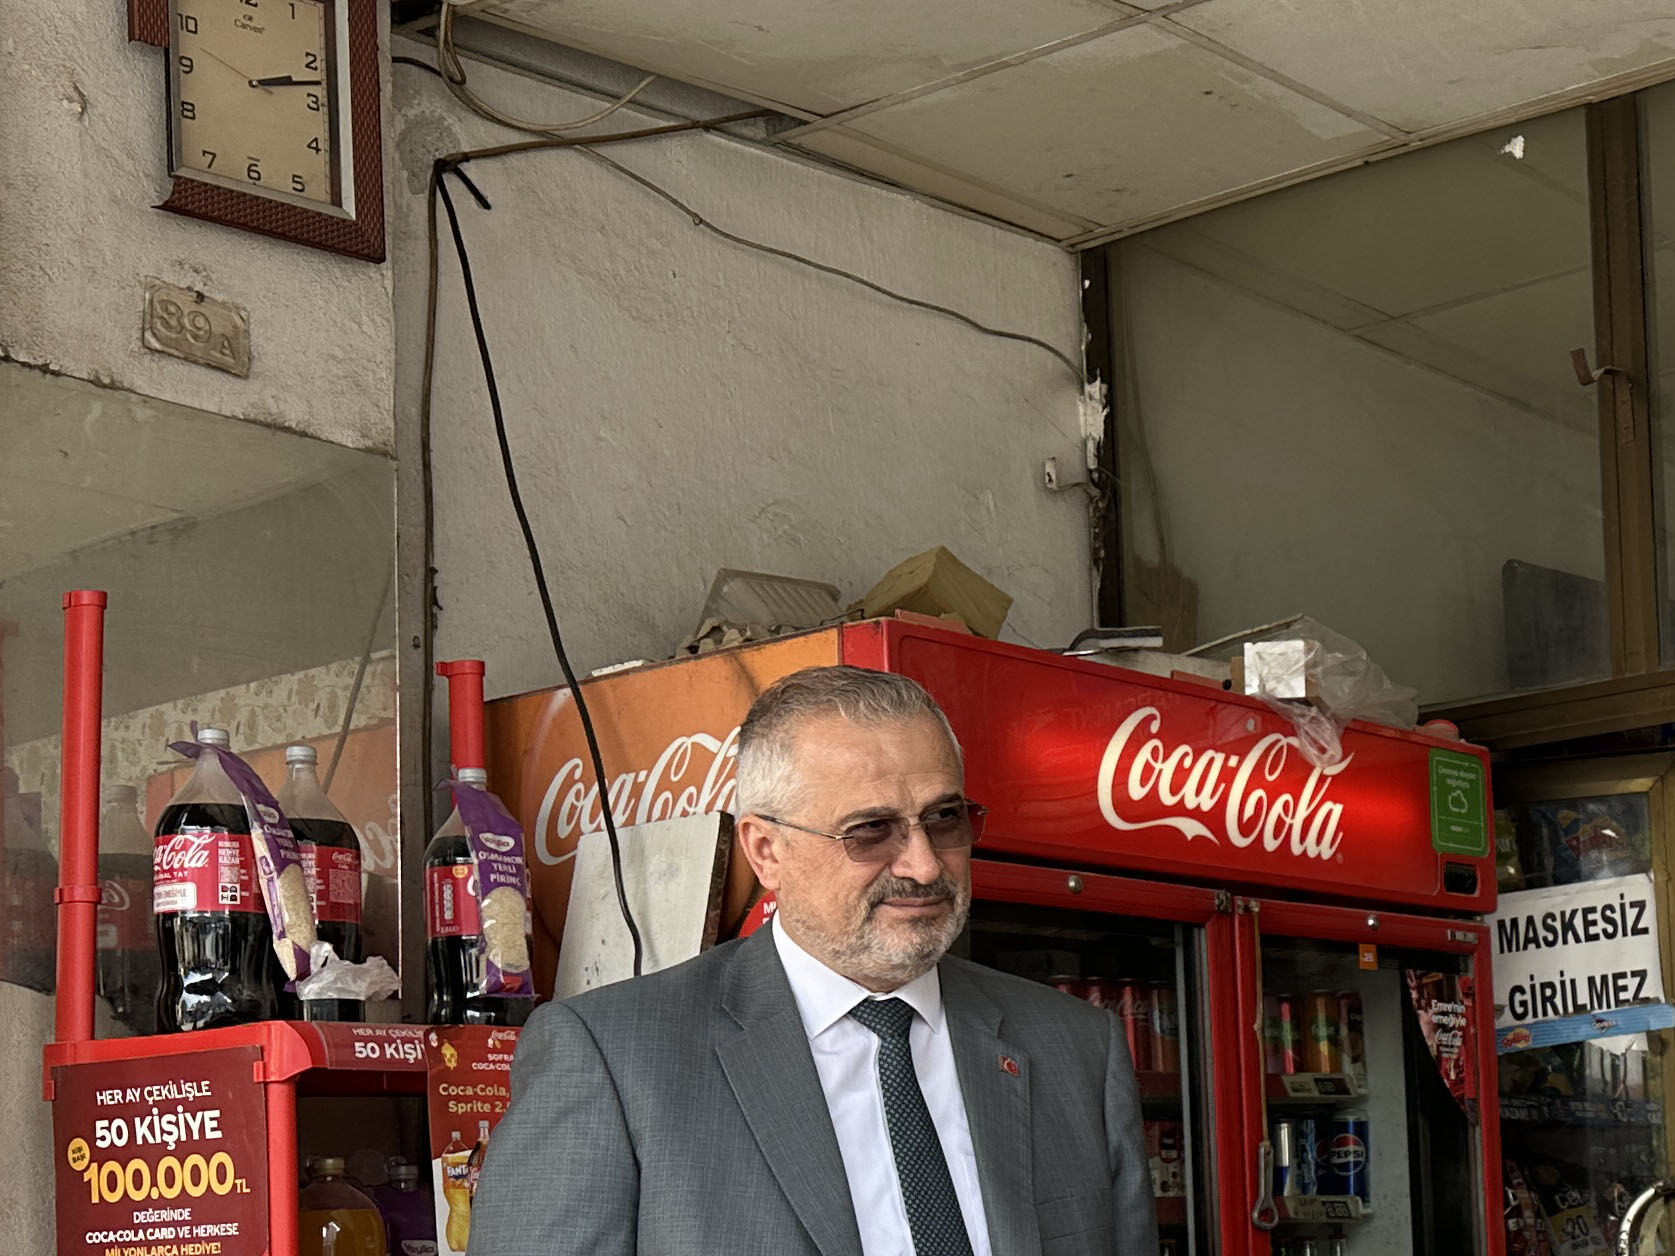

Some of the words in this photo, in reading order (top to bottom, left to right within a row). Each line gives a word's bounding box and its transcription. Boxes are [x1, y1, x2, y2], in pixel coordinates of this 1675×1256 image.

[178, 13, 199, 35] 10
[179, 55, 194, 75] 9
[304, 52, 319, 71] 2
[181, 101, 197, 121] 8
[306, 92, 321, 112] 3
[306, 136, 322, 155] 4
[202, 149, 218, 169] 7
[247, 163, 262, 182] 6
[291, 174, 306, 193] 5
[1097, 705, 1355, 862] Coca-Cola
[1496, 892, 1650, 956] MASKESİZ
[1507, 969, 1649, 1022] GİRİLMEZ
[354, 1041, 381, 1059] 50
[384, 1039, 426, 1064] KİŞİ
[471, 1062, 512, 1071] COCA-COL
[96, 1088, 123, 1106] HER
[125, 1087, 141, 1103] AY
[144, 1080, 212, 1105] ÇEKİLİŞLE
[448, 1100, 491, 1115] Sprite
[95, 1118, 129, 1149] 50
[134, 1105, 223, 1150] KİŞİYE
[83, 1151, 235, 1204] 100.000
[235, 1178, 251, 1194] TL
[133, 1206, 192, 1224] DEĞERİNDE
[146, 1227, 175, 1242] CARD
[177, 1225, 191, 1239] VE
[193, 1222, 240, 1238] HERKESE
